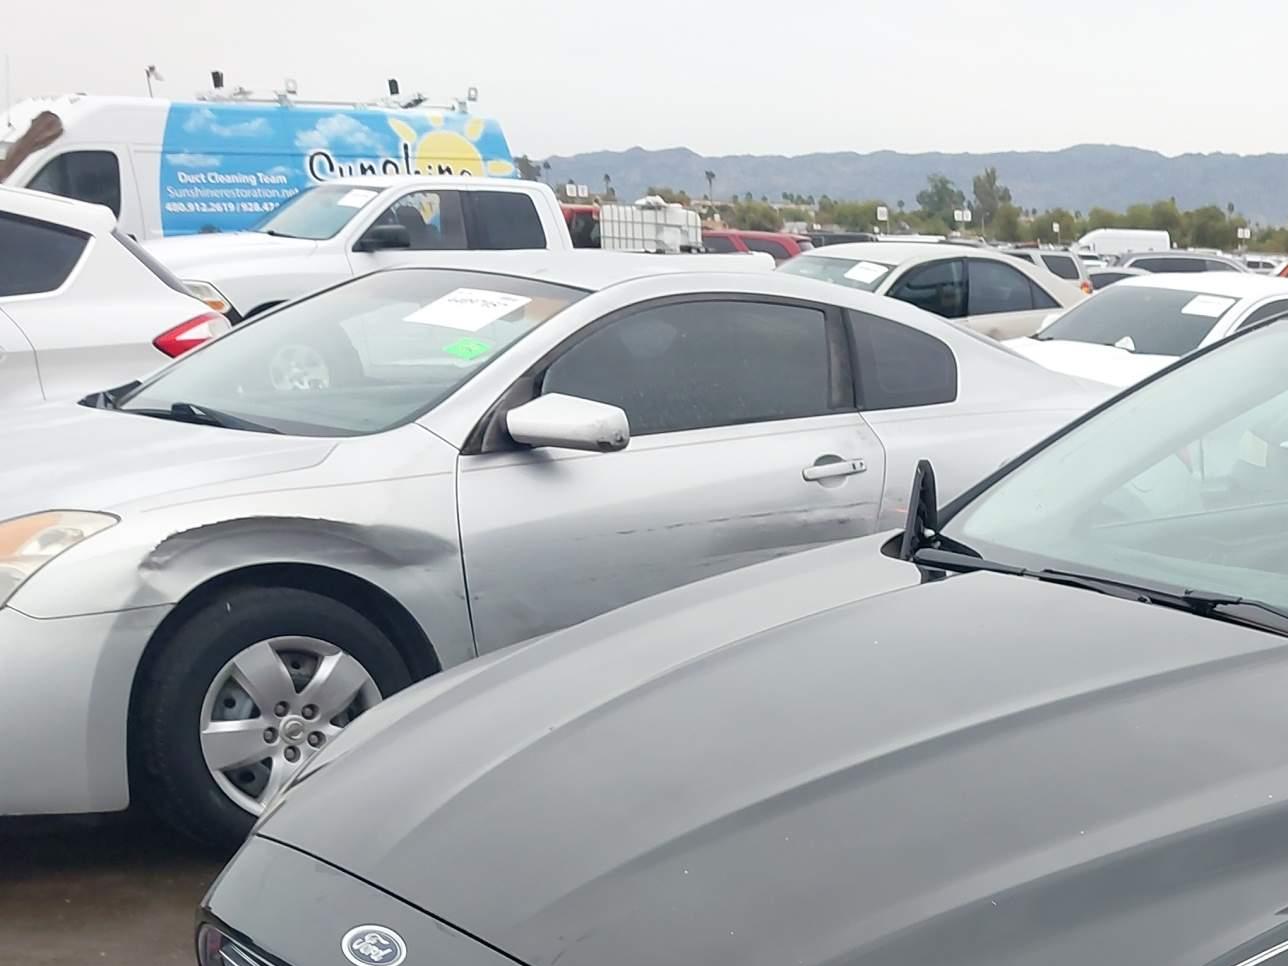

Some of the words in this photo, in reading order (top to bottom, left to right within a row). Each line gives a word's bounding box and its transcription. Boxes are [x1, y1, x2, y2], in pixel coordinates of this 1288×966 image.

[177, 171, 206, 183] Duct
[207, 172, 257, 186] Cleaning
[257, 172, 288, 184] Team
